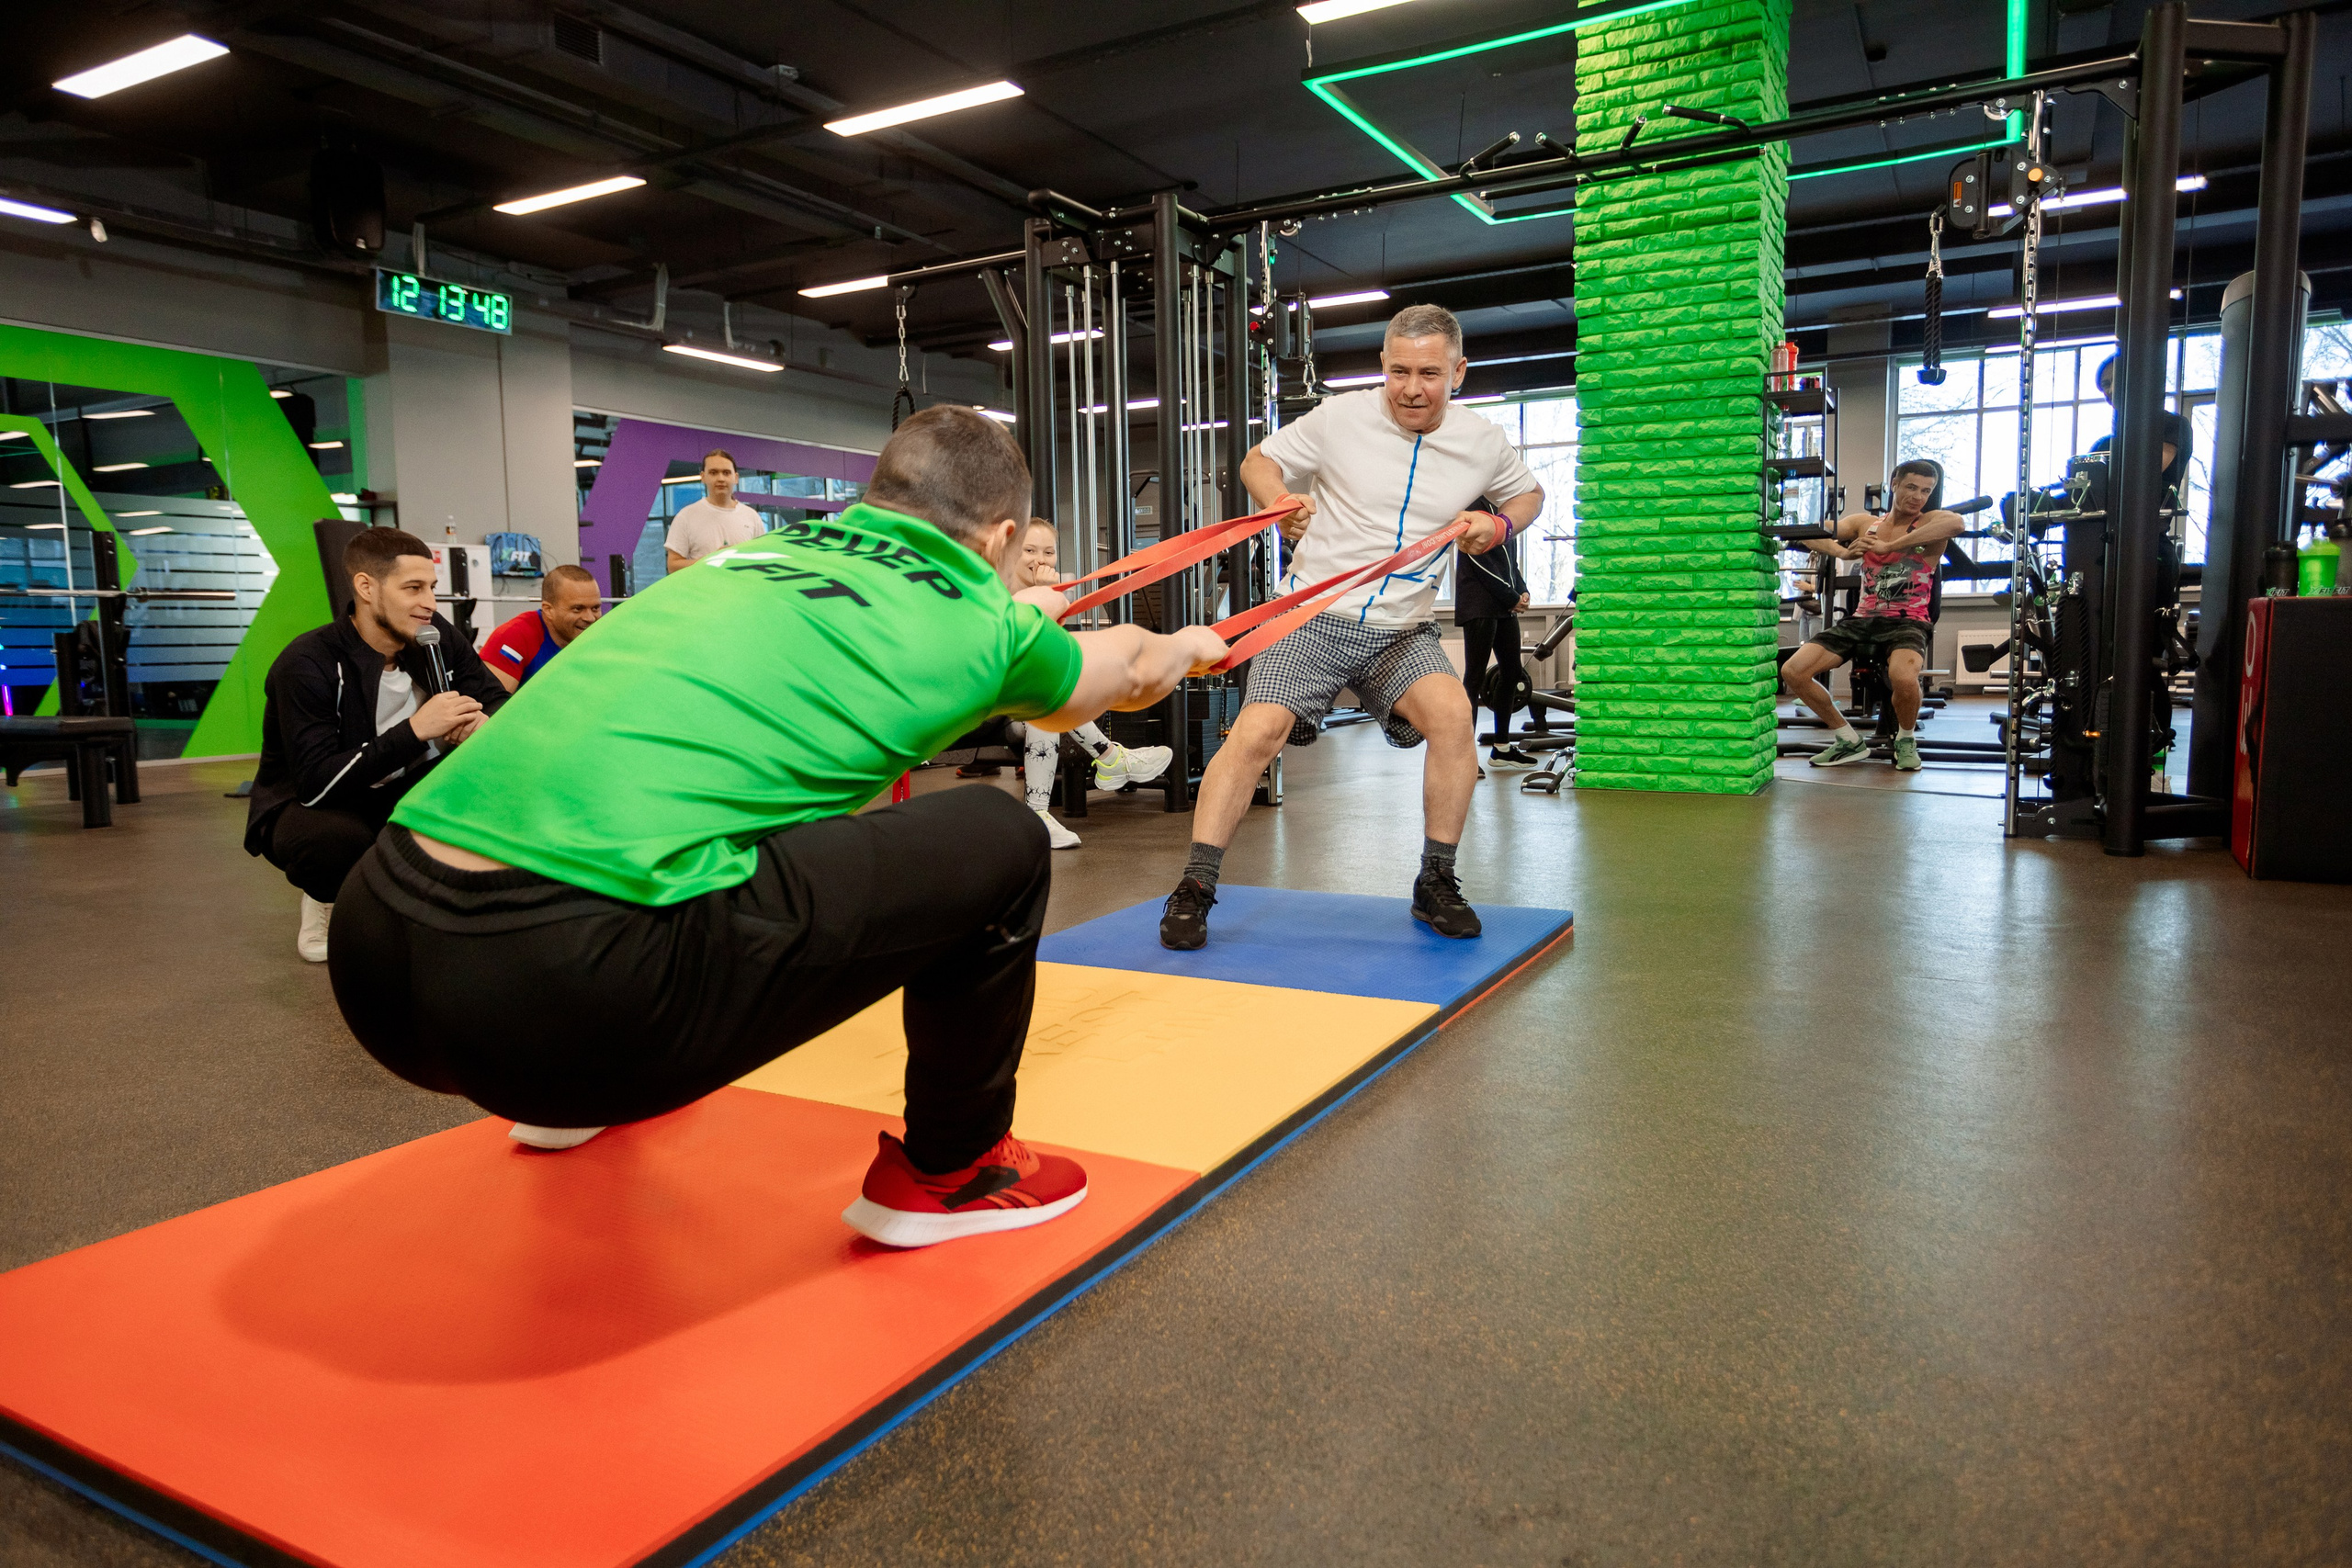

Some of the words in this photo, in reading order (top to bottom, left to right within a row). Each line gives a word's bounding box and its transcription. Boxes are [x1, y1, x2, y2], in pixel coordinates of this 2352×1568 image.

[392, 275, 420, 313] 12
[439, 285, 466, 321] 13
[472, 292, 508, 330] 48
[500, 547, 532, 562] XFIT
[2266, 587, 2290, 597] XFIT
